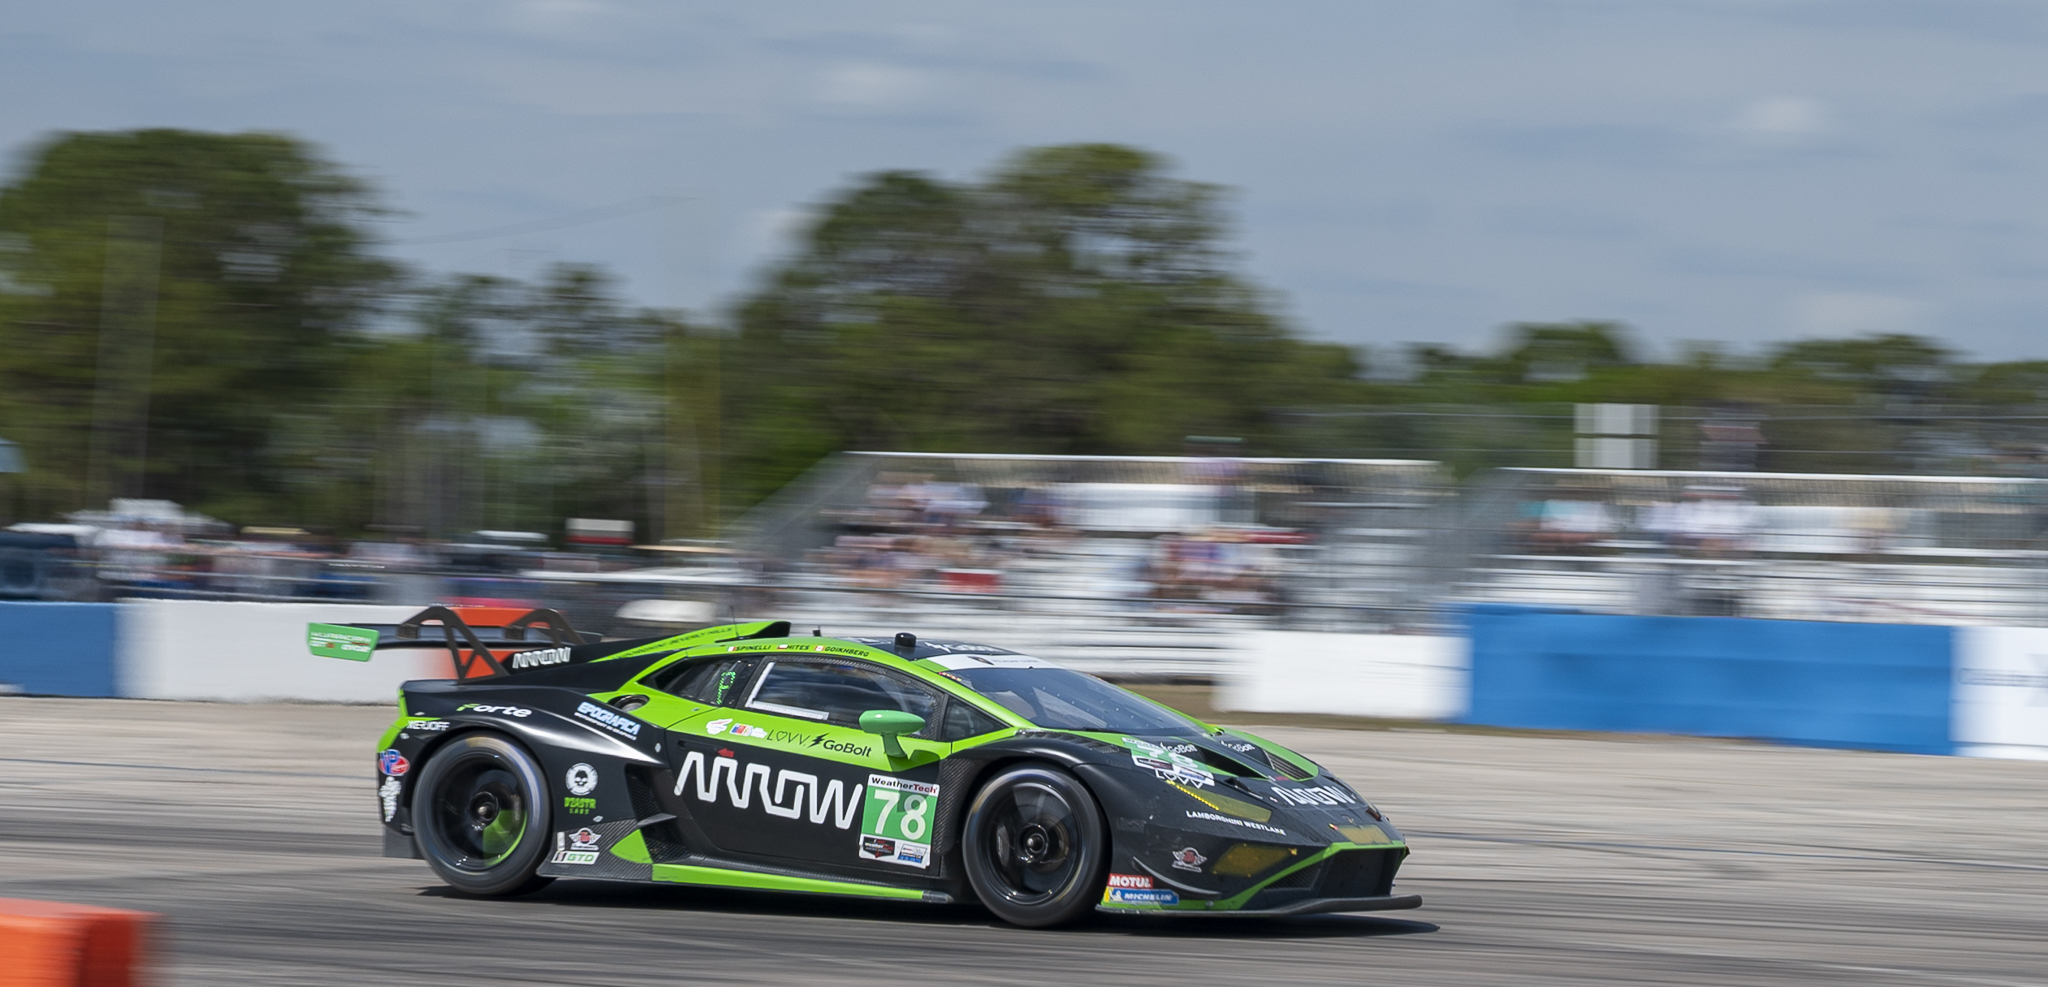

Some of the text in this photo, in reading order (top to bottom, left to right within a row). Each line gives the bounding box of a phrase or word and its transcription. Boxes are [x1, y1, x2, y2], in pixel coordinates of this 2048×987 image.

[512, 646, 571, 669] ARROW
[824, 646, 870, 658] GOIKHBERG
[456, 703, 532, 718] Forte
[577, 701, 641, 735] EPOGRAFICA
[823, 739, 872, 757] GoBolt
[674, 751, 863, 830] ARROW
[871, 777, 936, 794] WeatherTech
[874, 789, 927, 840] 78
[1186, 810, 1287, 836] LAMBORGHINI WESTLAKE
[567, 853, 594, 862] GTD
[1109, 876, 1152, 888] MOTUL
[1124, 892, 1173, 901] MICHELIN
